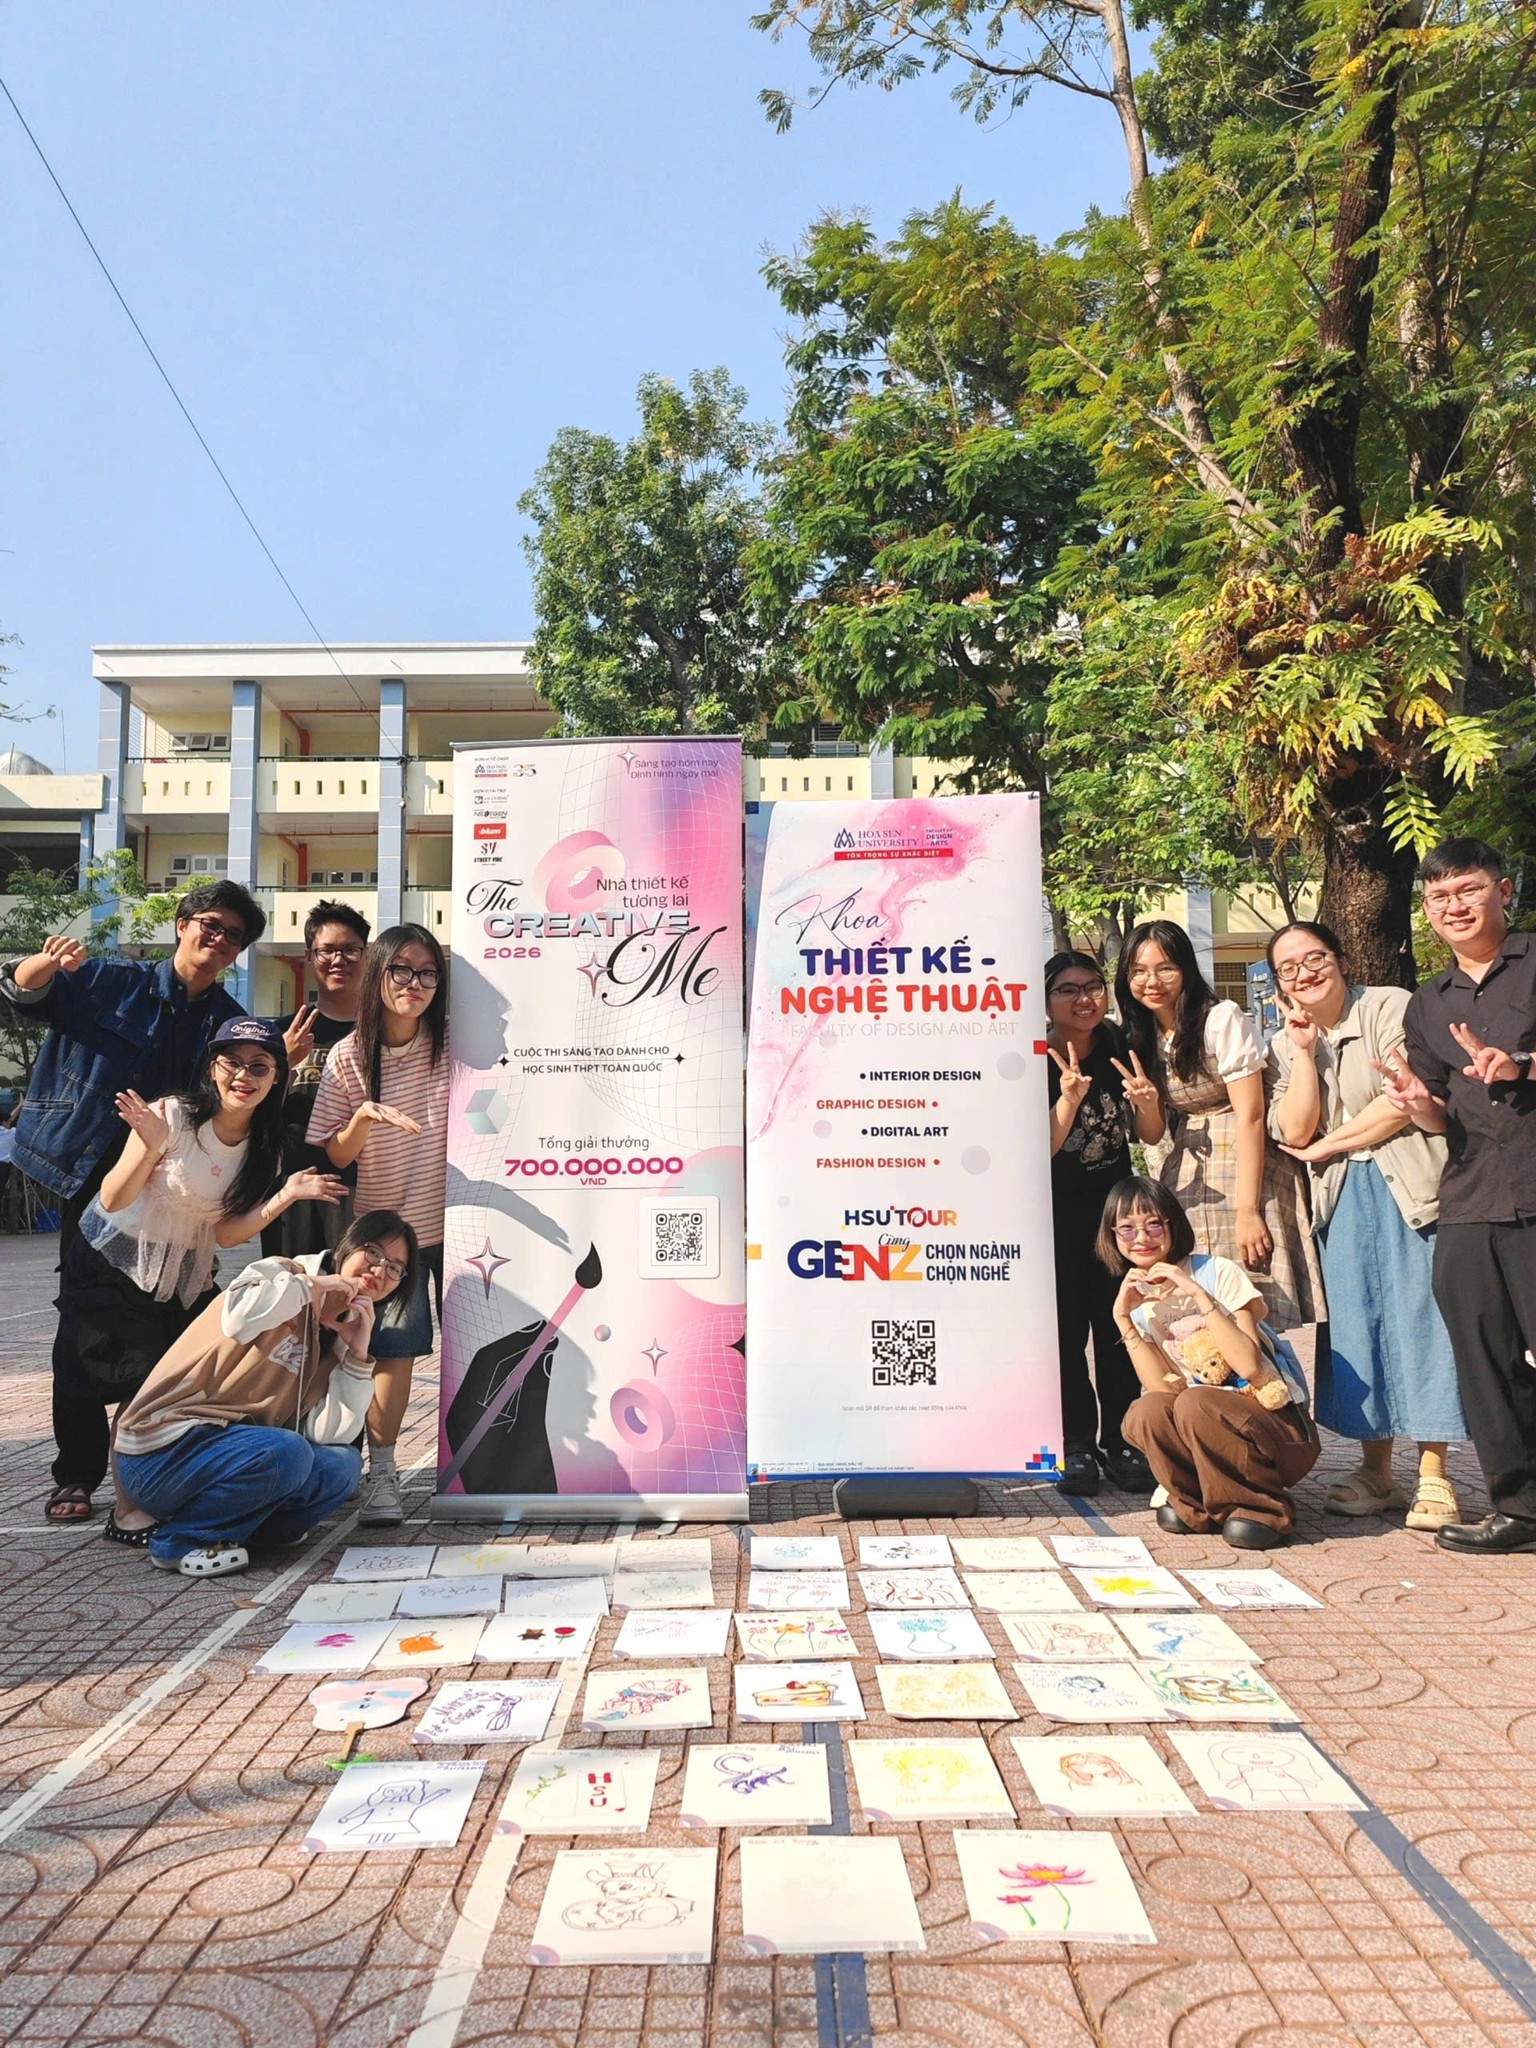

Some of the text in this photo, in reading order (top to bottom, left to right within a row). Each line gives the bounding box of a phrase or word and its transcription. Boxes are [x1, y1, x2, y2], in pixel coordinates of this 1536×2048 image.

[512, 763, 537, 777] 35
[702, 759, 719, 767] nay
[858, 829, 903, 839] HOA SEN
[858, 838, 920, 848] UNIVERSITY
[596, 874, 689, 891] Nhà thiết kế
[466, 878, 524, 915] The
[623, 893, 689, 909] tương lai
[483, 911, 690, 939] CREATIVE
[775, 887, 888, 950] Khoa
[483, 947, 541, 959] 2026
[799, 936, 913, 977] THIẾT
[922, 935, 972, 974] KẾ
[601, 926, 727, 1007] Me
[781, 976, 1028, 1020] NGHỆ THUẬT
[861, 1023, 882, 1036] OF
[887, 1022, 944, 1036] DESIGN
[948, 1022, 983, 1036] AND
[988, 1022, 1018, 1035] ART
[514, 1046, 543, 1059] CUỘC
[545, 1048, 561, 1056] THI
[564, 1045, 592, 1056] SÁNG
[617, 1045, 646, 1055] DÀNH
[648, 1046, 670, 1055] CHO
[522, 1061, 663, 1075] HỌC SINH THPT TOÀN QUỐC
[869, 1070, 982, 1081] INTERIOR DESIGN
[816, 1099, 926, 1110] GRAPHIC DESIGN
[870, 1126, 949, 1137] DIGITAL ART
[538, 1135, 650, 1151] Tổng giải thưởng
[505, 1156, 684, 1176] 700.000.000
[816, 1158, 926, 1168] FASHION DESIGN
[926, 1241, 1021, 1262] CHỌN NGÀNH
[926, 1260, 1011, 1284] CHỌN NGHỀ
